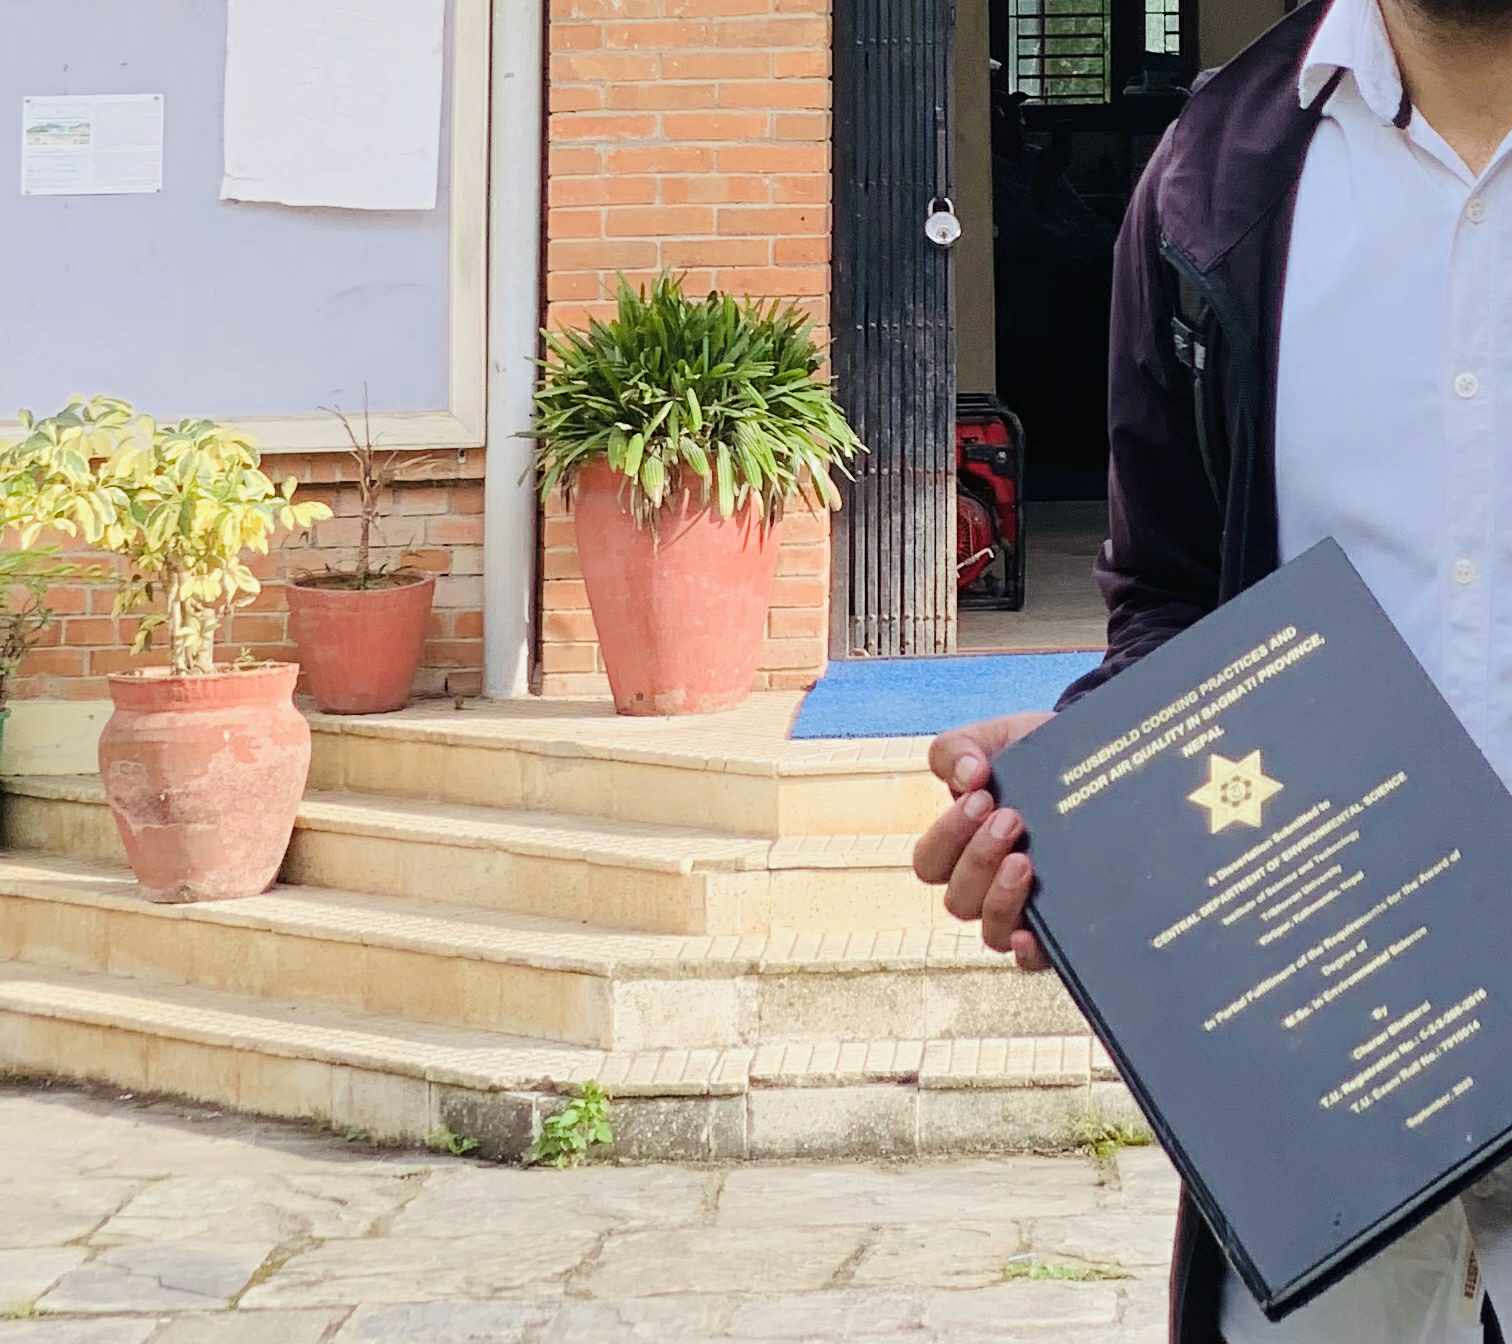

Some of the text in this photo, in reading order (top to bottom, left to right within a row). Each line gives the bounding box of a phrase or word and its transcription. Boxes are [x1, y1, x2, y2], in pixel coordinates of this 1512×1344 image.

[1057, 633, 1325, 813] INDOOR AIR QUALITY IN BAGMATI PROVINCE,
[1062, 626, 1296, 785] HOUSEHOLD COOKING PRACTICES AND
[1181, 725, 1224, 757] NEPAL
[1152, 771, 1406, 948] CENTRAL DEPARTMENT OF ENVIRONMENTAL SCIENCE
[1208, 876, 1217, 886] A
[1295, 953, 1307, 968] of
[1306, 945, 1324, 960] the
[1386, 890, 1401, 905] for
[1401, 880, 1419, 895] the
[1449, 848, 1460, 862] of
[1355, 938, 1367, 952] of
